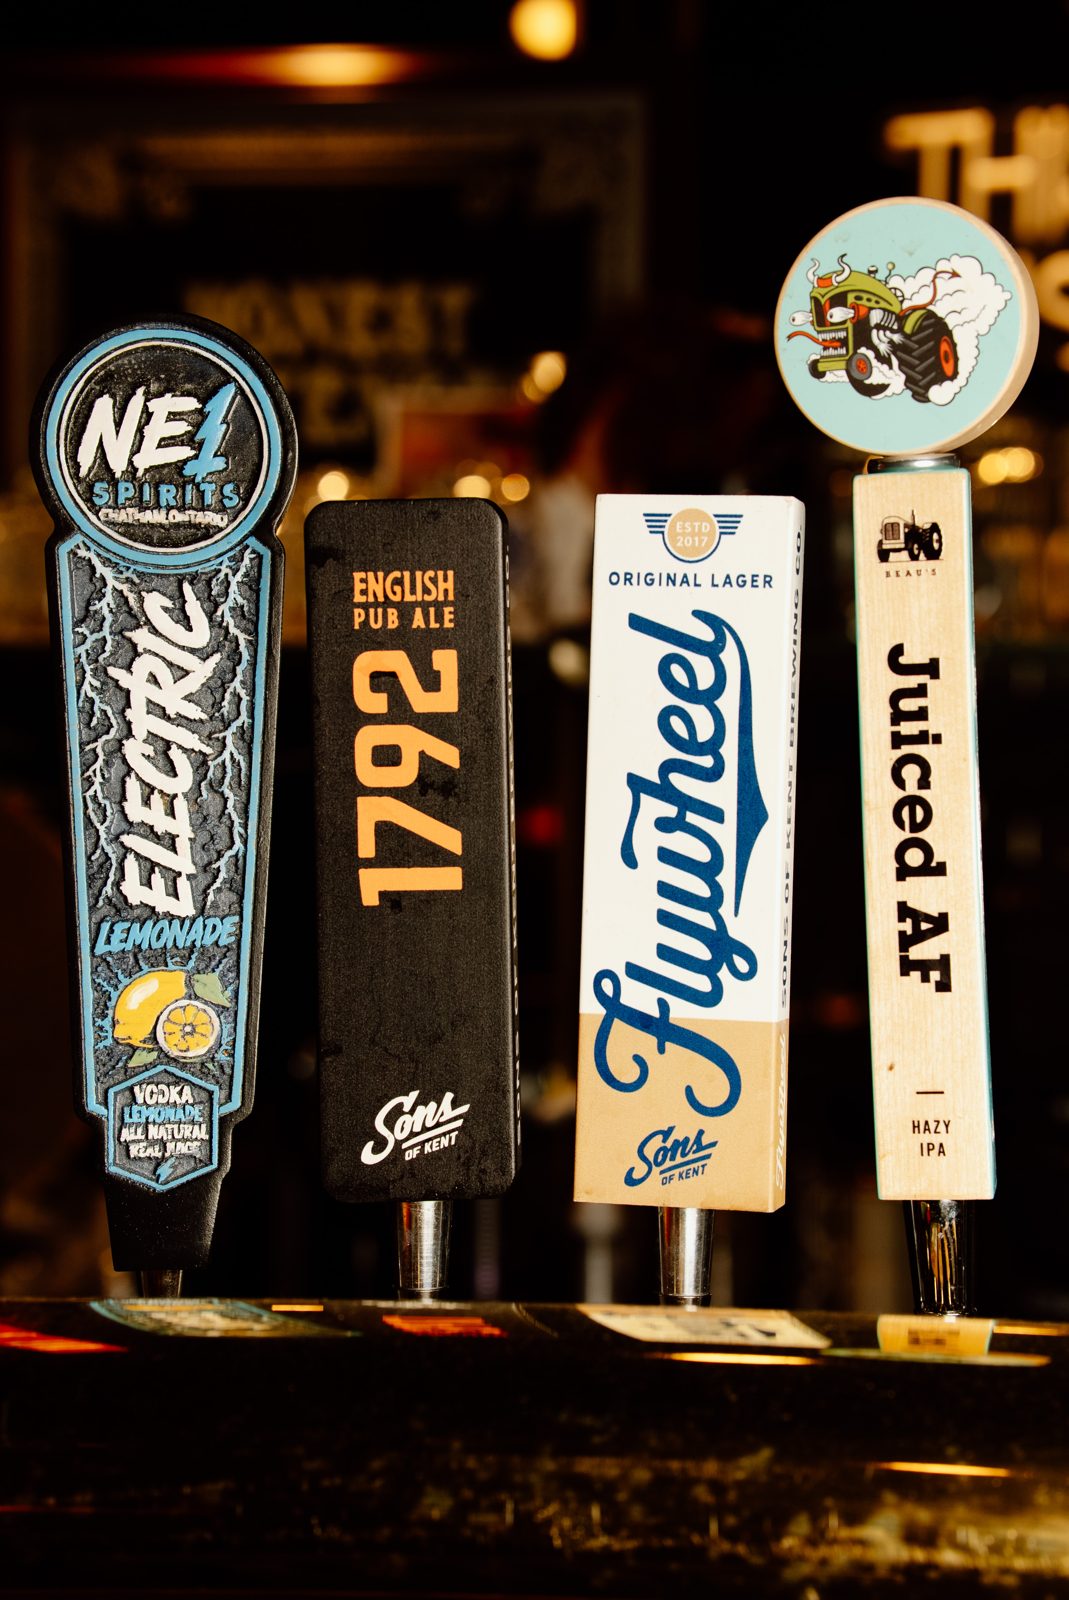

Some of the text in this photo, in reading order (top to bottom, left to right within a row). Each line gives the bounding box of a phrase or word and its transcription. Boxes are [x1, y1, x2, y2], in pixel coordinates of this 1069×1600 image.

[77, 382, 236, 483] NE1
[91, 481, 241, 509] SPIRITS
[675, 521, 711, 534] ESTD
[675, 535, 709, 548] 2017
[608, 571, 774, 589] ORIGINAL LAGER
[885, 567, 938, 579] BEAU'S
[352, 569, 455, 603] ENGLISH
[353, 606, 456, 630] PUB ALE
[107, 581, 222, 917] ELECTRIC
[352, 648, 463, 906] 1792
[887, 642, 952, 993] Juiced AF
[592, 608, 769, 1118] Flywheel
[94, 916, 240, 956] LEMONADE
[133, 1083, 194, 1105] VODKA
[123, 1104, 203, 1123] LEMONADE
[120, 1123, 209, 1142] ALL NATURAL
[360, 1089, 471, 1165] Sons
[911, 1119, 951, 1134] HAZY
[128, 1141, 163, 1158] REAL
[404, 1131, 459, 1161] OF KENT
[623, 1125, 719, 1187] Sons
[920, 1142, 947, 1157] IPA
[660, 1163, 708, 1186] OF KENT
